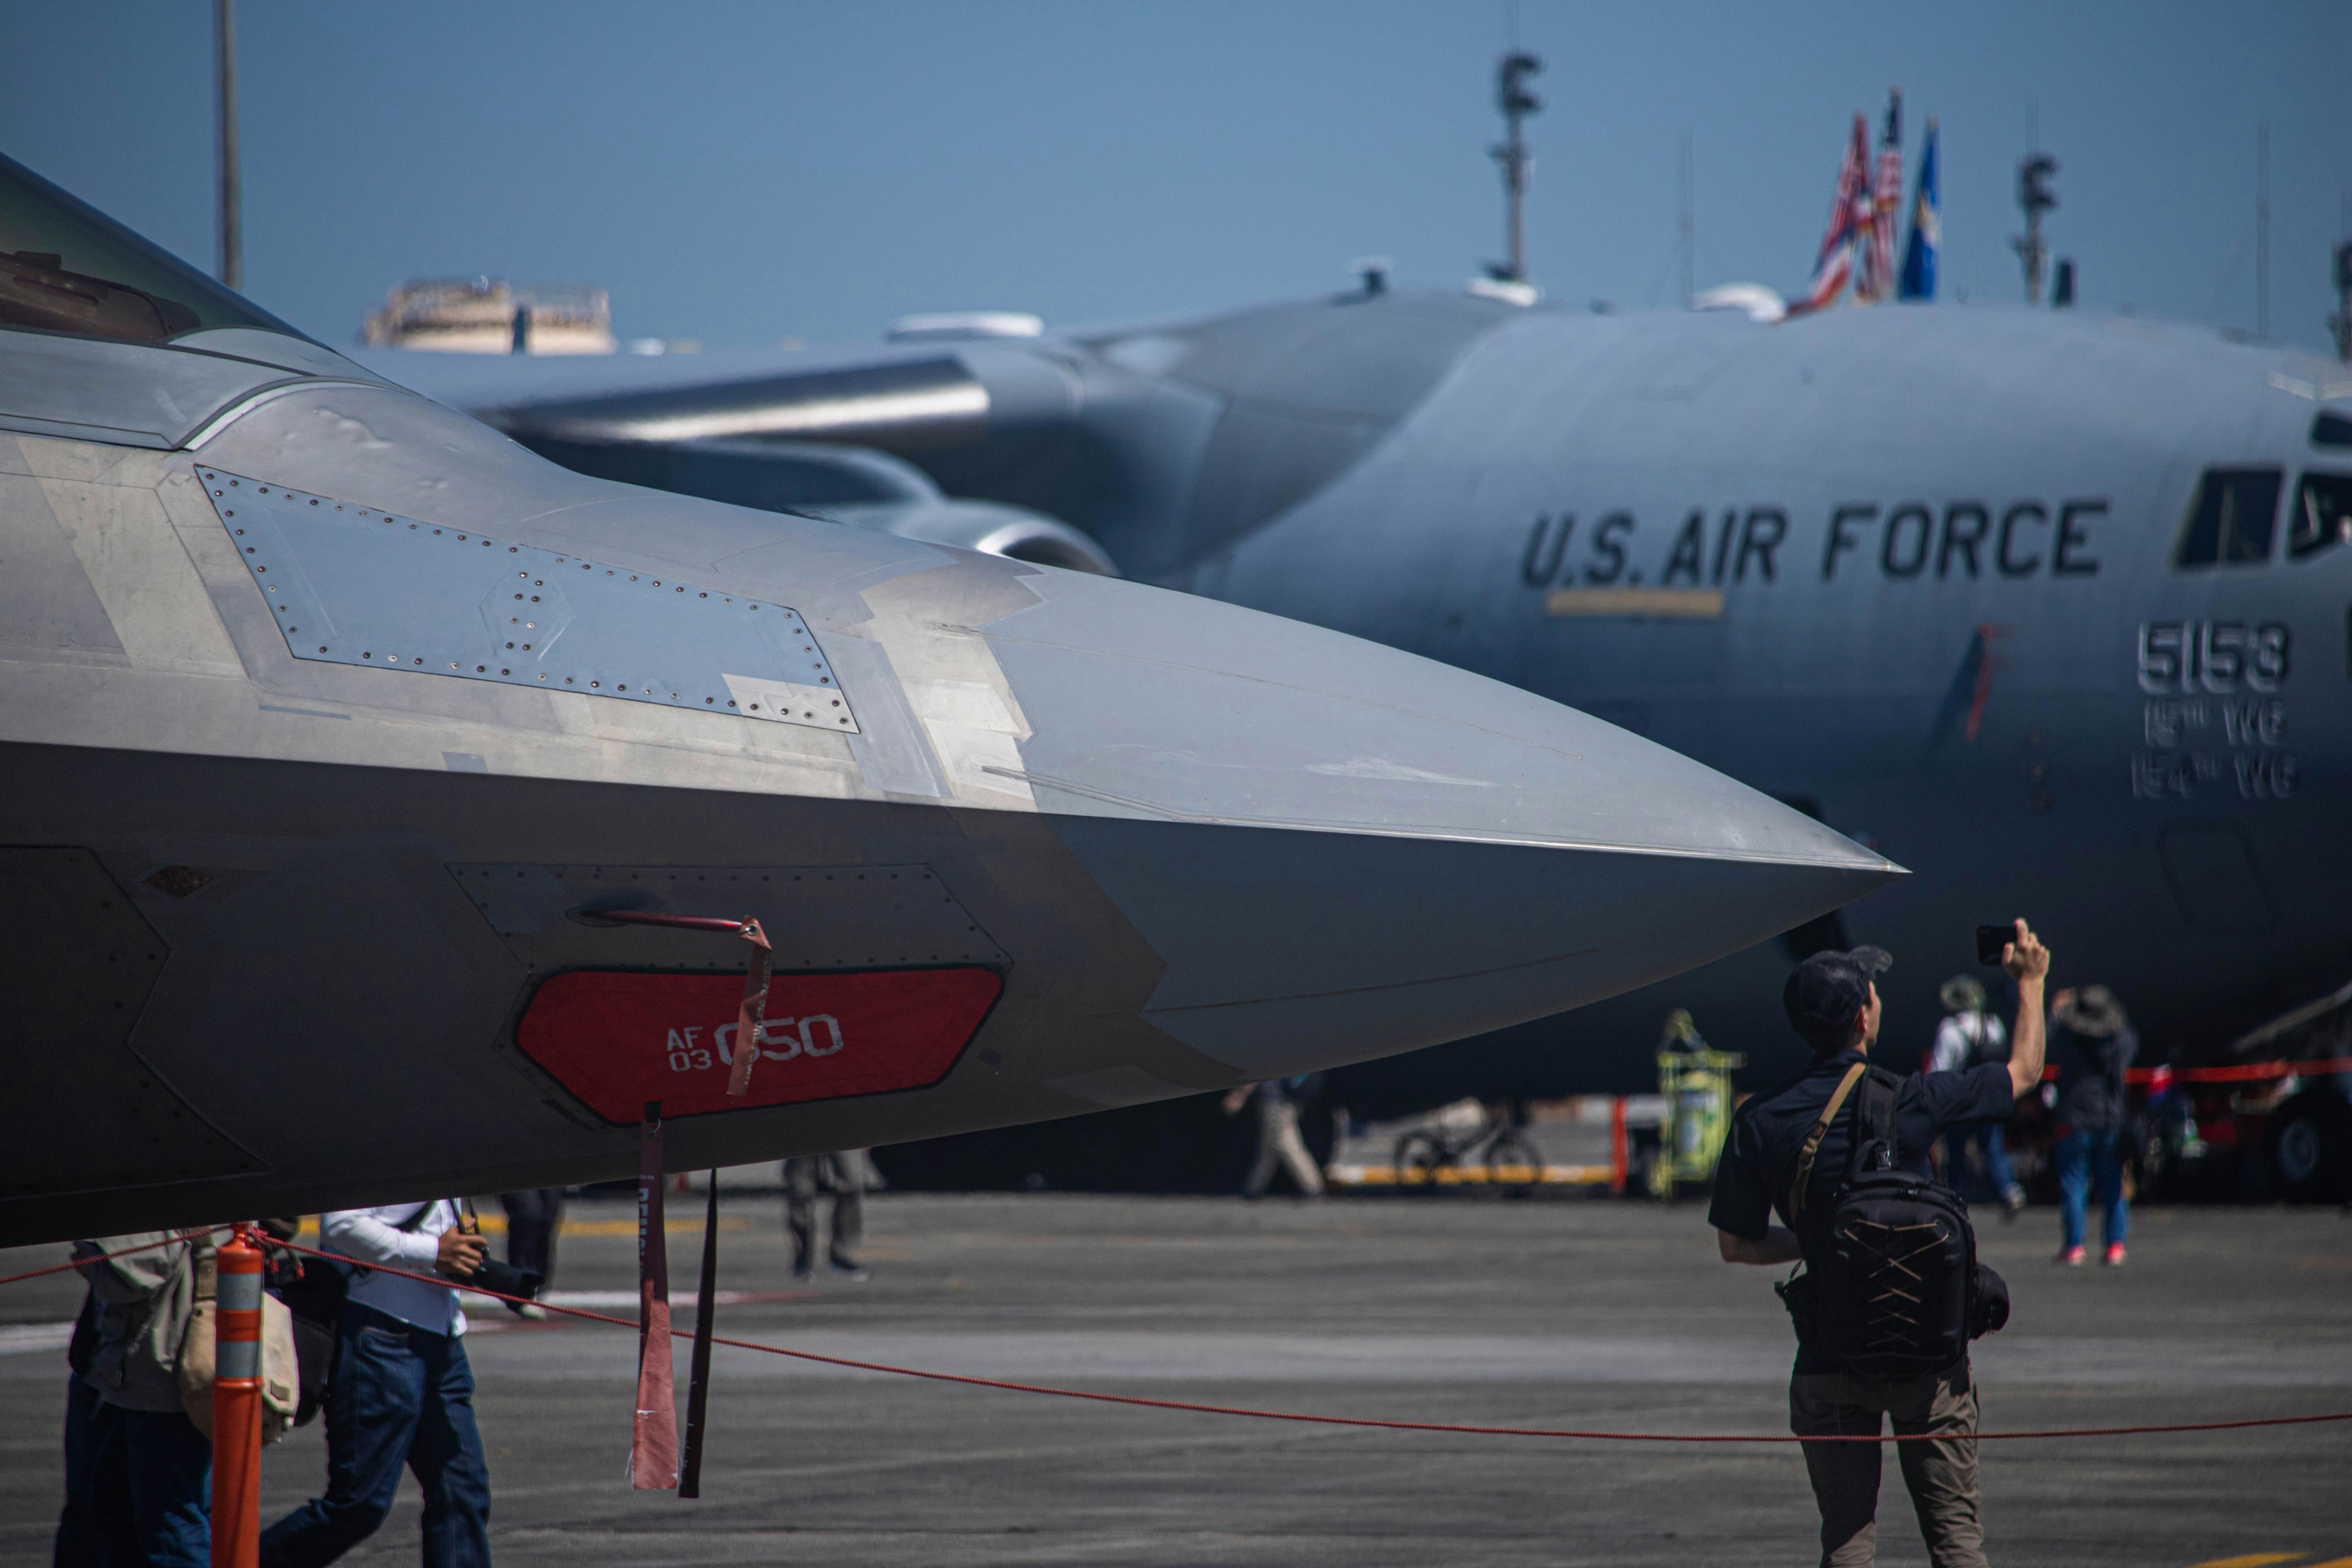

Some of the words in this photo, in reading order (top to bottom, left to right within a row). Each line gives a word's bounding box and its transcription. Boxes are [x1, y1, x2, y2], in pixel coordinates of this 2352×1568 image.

[1522, 510, 1642, 586] U.S.
[1660, 505, 1790, 584] AIR
[1820, 496, 2111, 582] FORCE
[2136, 620, 2290, 695] 5153
[667, 1026, 703, 1051] AF
[669, 1049, 712, 1072] 03
[713, 1014, 844, 1066] 050
